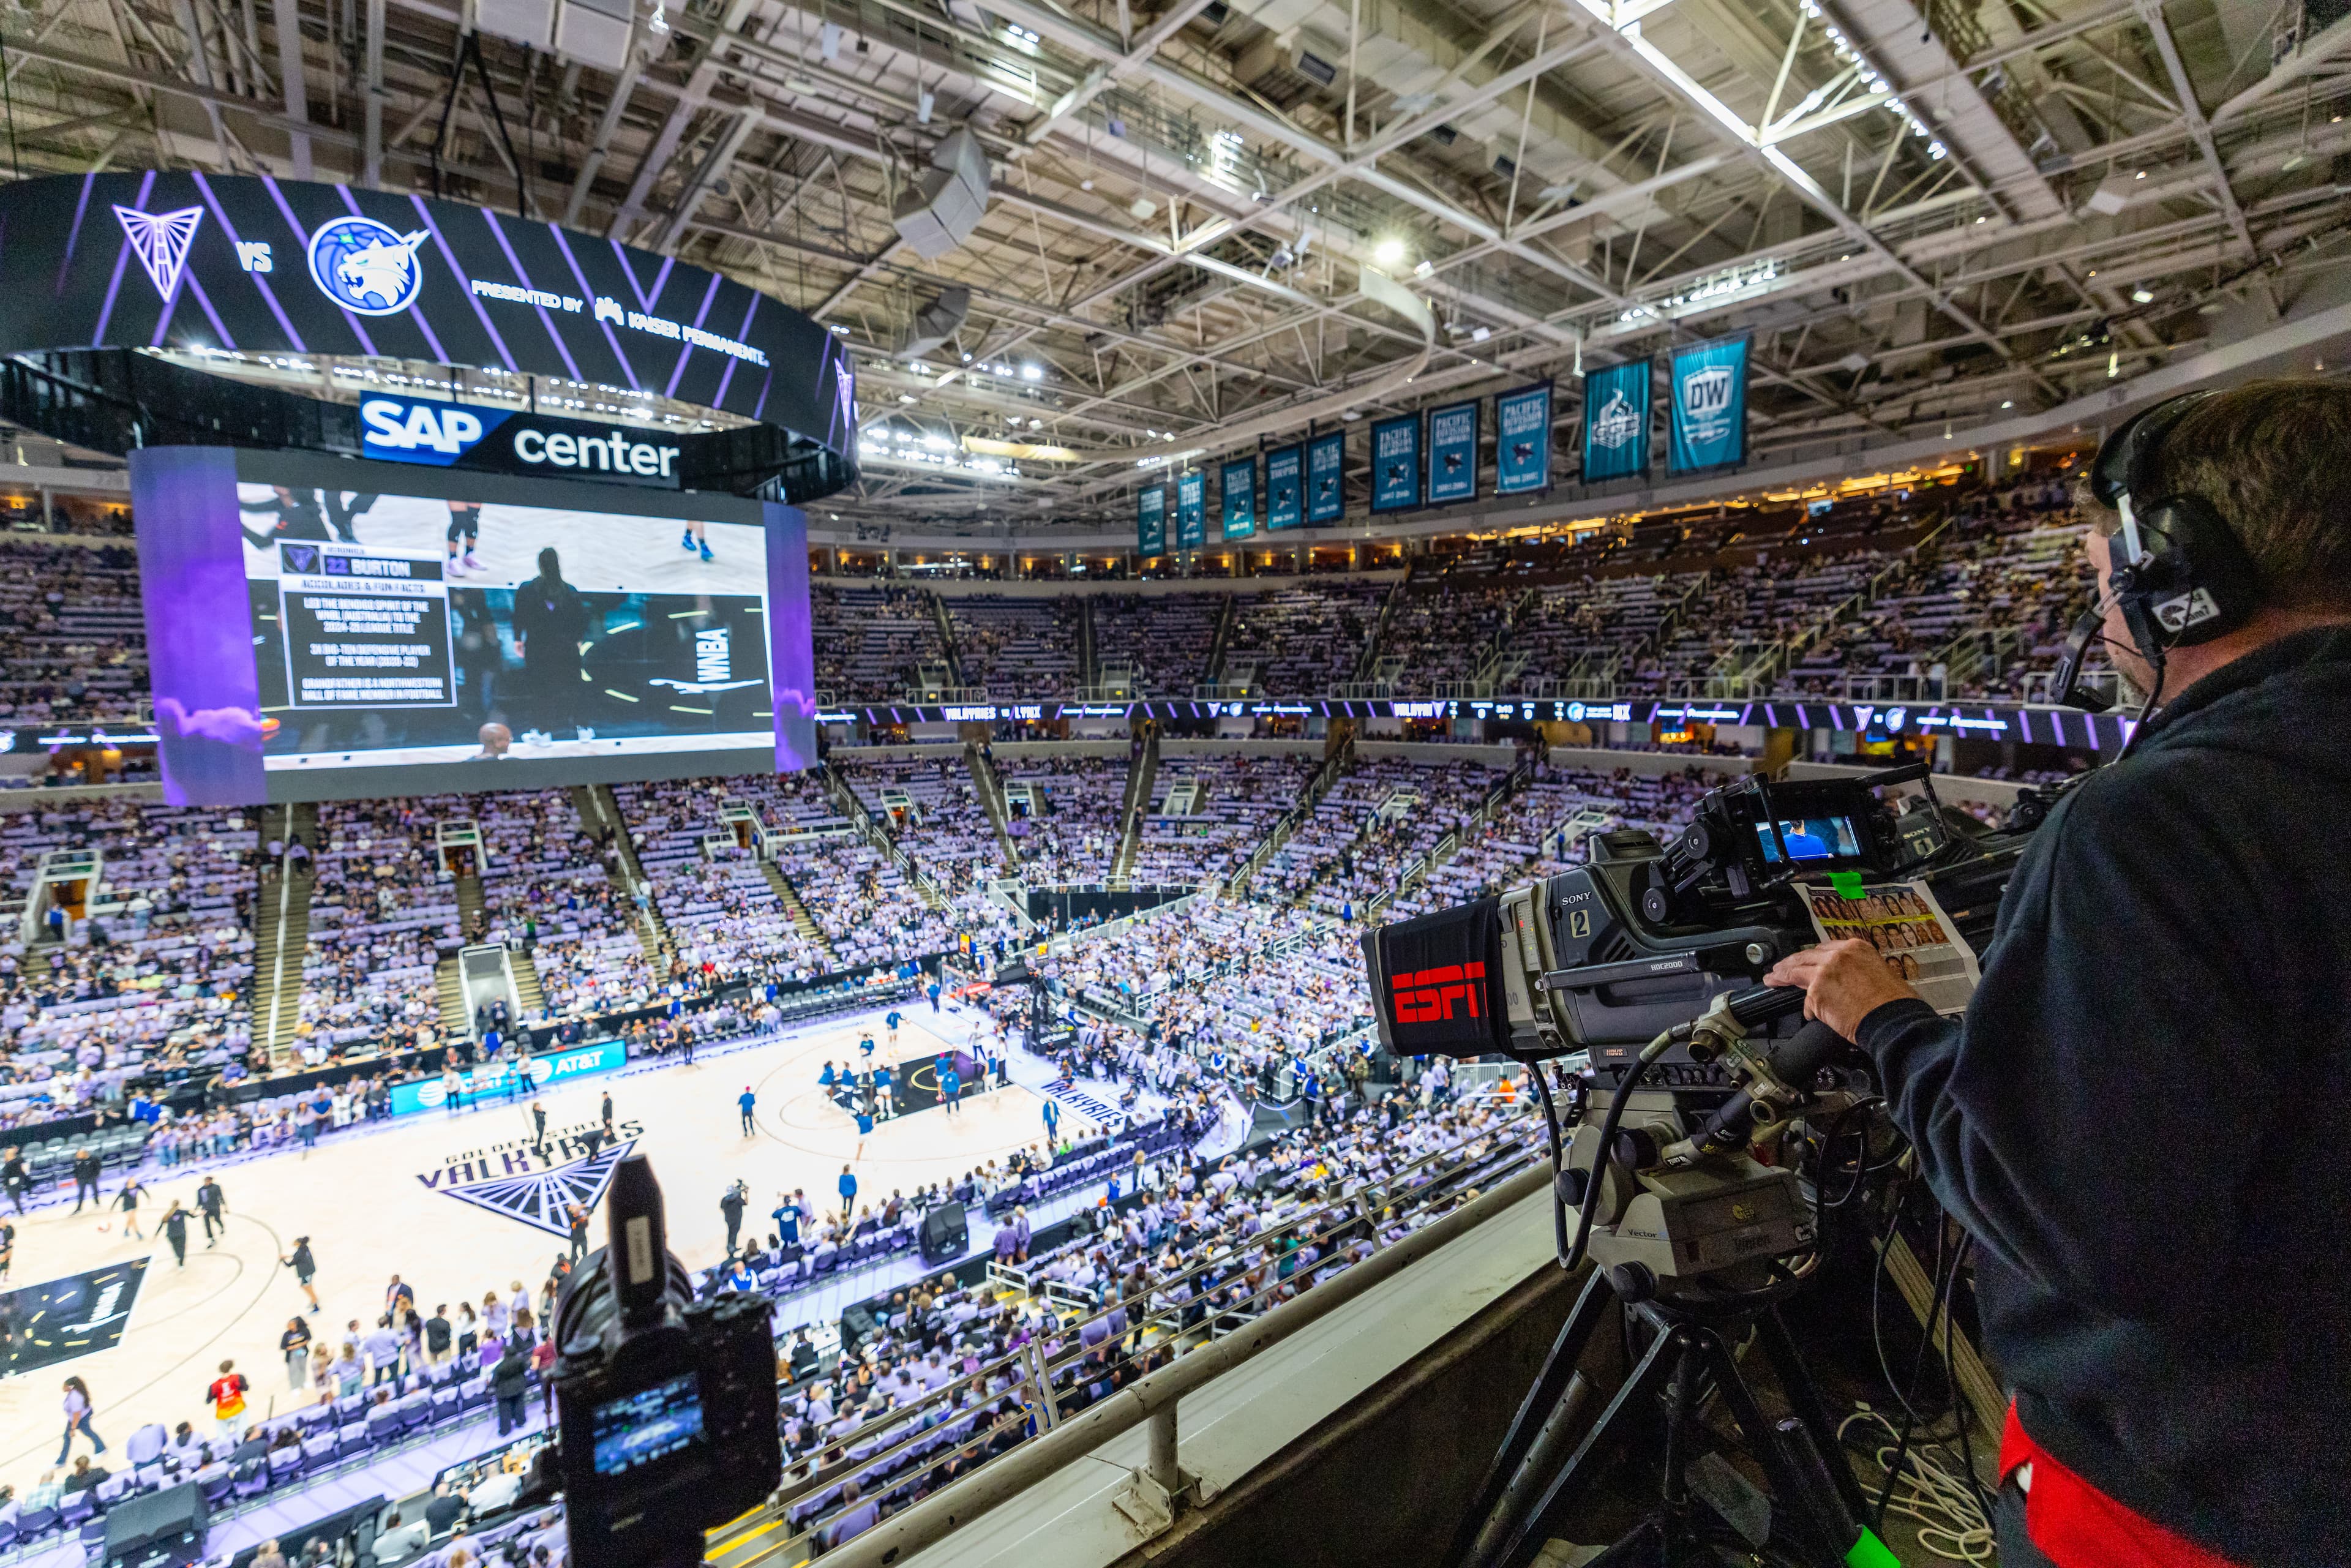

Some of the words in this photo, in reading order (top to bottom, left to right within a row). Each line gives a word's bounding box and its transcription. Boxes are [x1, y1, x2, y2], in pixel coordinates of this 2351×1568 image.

[236, 242, 274, 272] VS
[470, 280, 561, 309] PRESENTED
[561, 296, 583, 313] BY
[628, 312, 680, 339] KAISER
[1690, 377, 1727, 410] DW
[1505, 400, 1542, 416] PACIFIC
[362, 400, 482, 454] SAP
[1436, 411, 1471, 429] PACIFIC
[1379, 426, 1412, 441] PACIFIC
[514, 429, 679, 477] center
[326, 558, 349, 574] 22
[351, 558, 411, 577] BURTON
[301, 579, 361, 591] ACCOLADES
[363, 582, 372, 591] &
[374, 583, 393, 592] FUN
[396, 583, 426, 594] FACTS
[322, 598, 337, 609] THE
[401, 601, 413, 611] OF
[413, 601, 429, 612] THE
[393, 612, 404, 622] TO
[404, 612, 421, 623] THE
[393, 623, 416, 634] TITLE
[357, 644, 401, 655] DEFENSIVE
[401, 644, 431, 656] PLAYER
[696, 628, 730, 683] WNBA
[325, 655, 338, 666] OF
[339, 656, 355, 666] THE
[355, 656, 377, 667] YEAR
[945, 708, 997, 720] VALKYRIES
[1014, 706, 1041, 719] LYNX
[1902, 826, 1931, 839] SONY
[1919, 839, 1929, 852] 1
[1562, 891, 1591, 906] SONY
[1574, 911, 1588, 936] 2
[1651, 961, 1683, 970] HDC2000
[1392, 961, 1489, 1023] ESPN
[555, 1050, 604, 1076] AT&T
[1040, 1079, 1123, 1127] VALKYRIES
[446, 1136, 534, 1165] GOLDEN
[545, 1120, 598, 1139] STAT
[416, 1119, 645, 1188] VALKYRS
[1627, 1228, 1657, 1239] Vector
